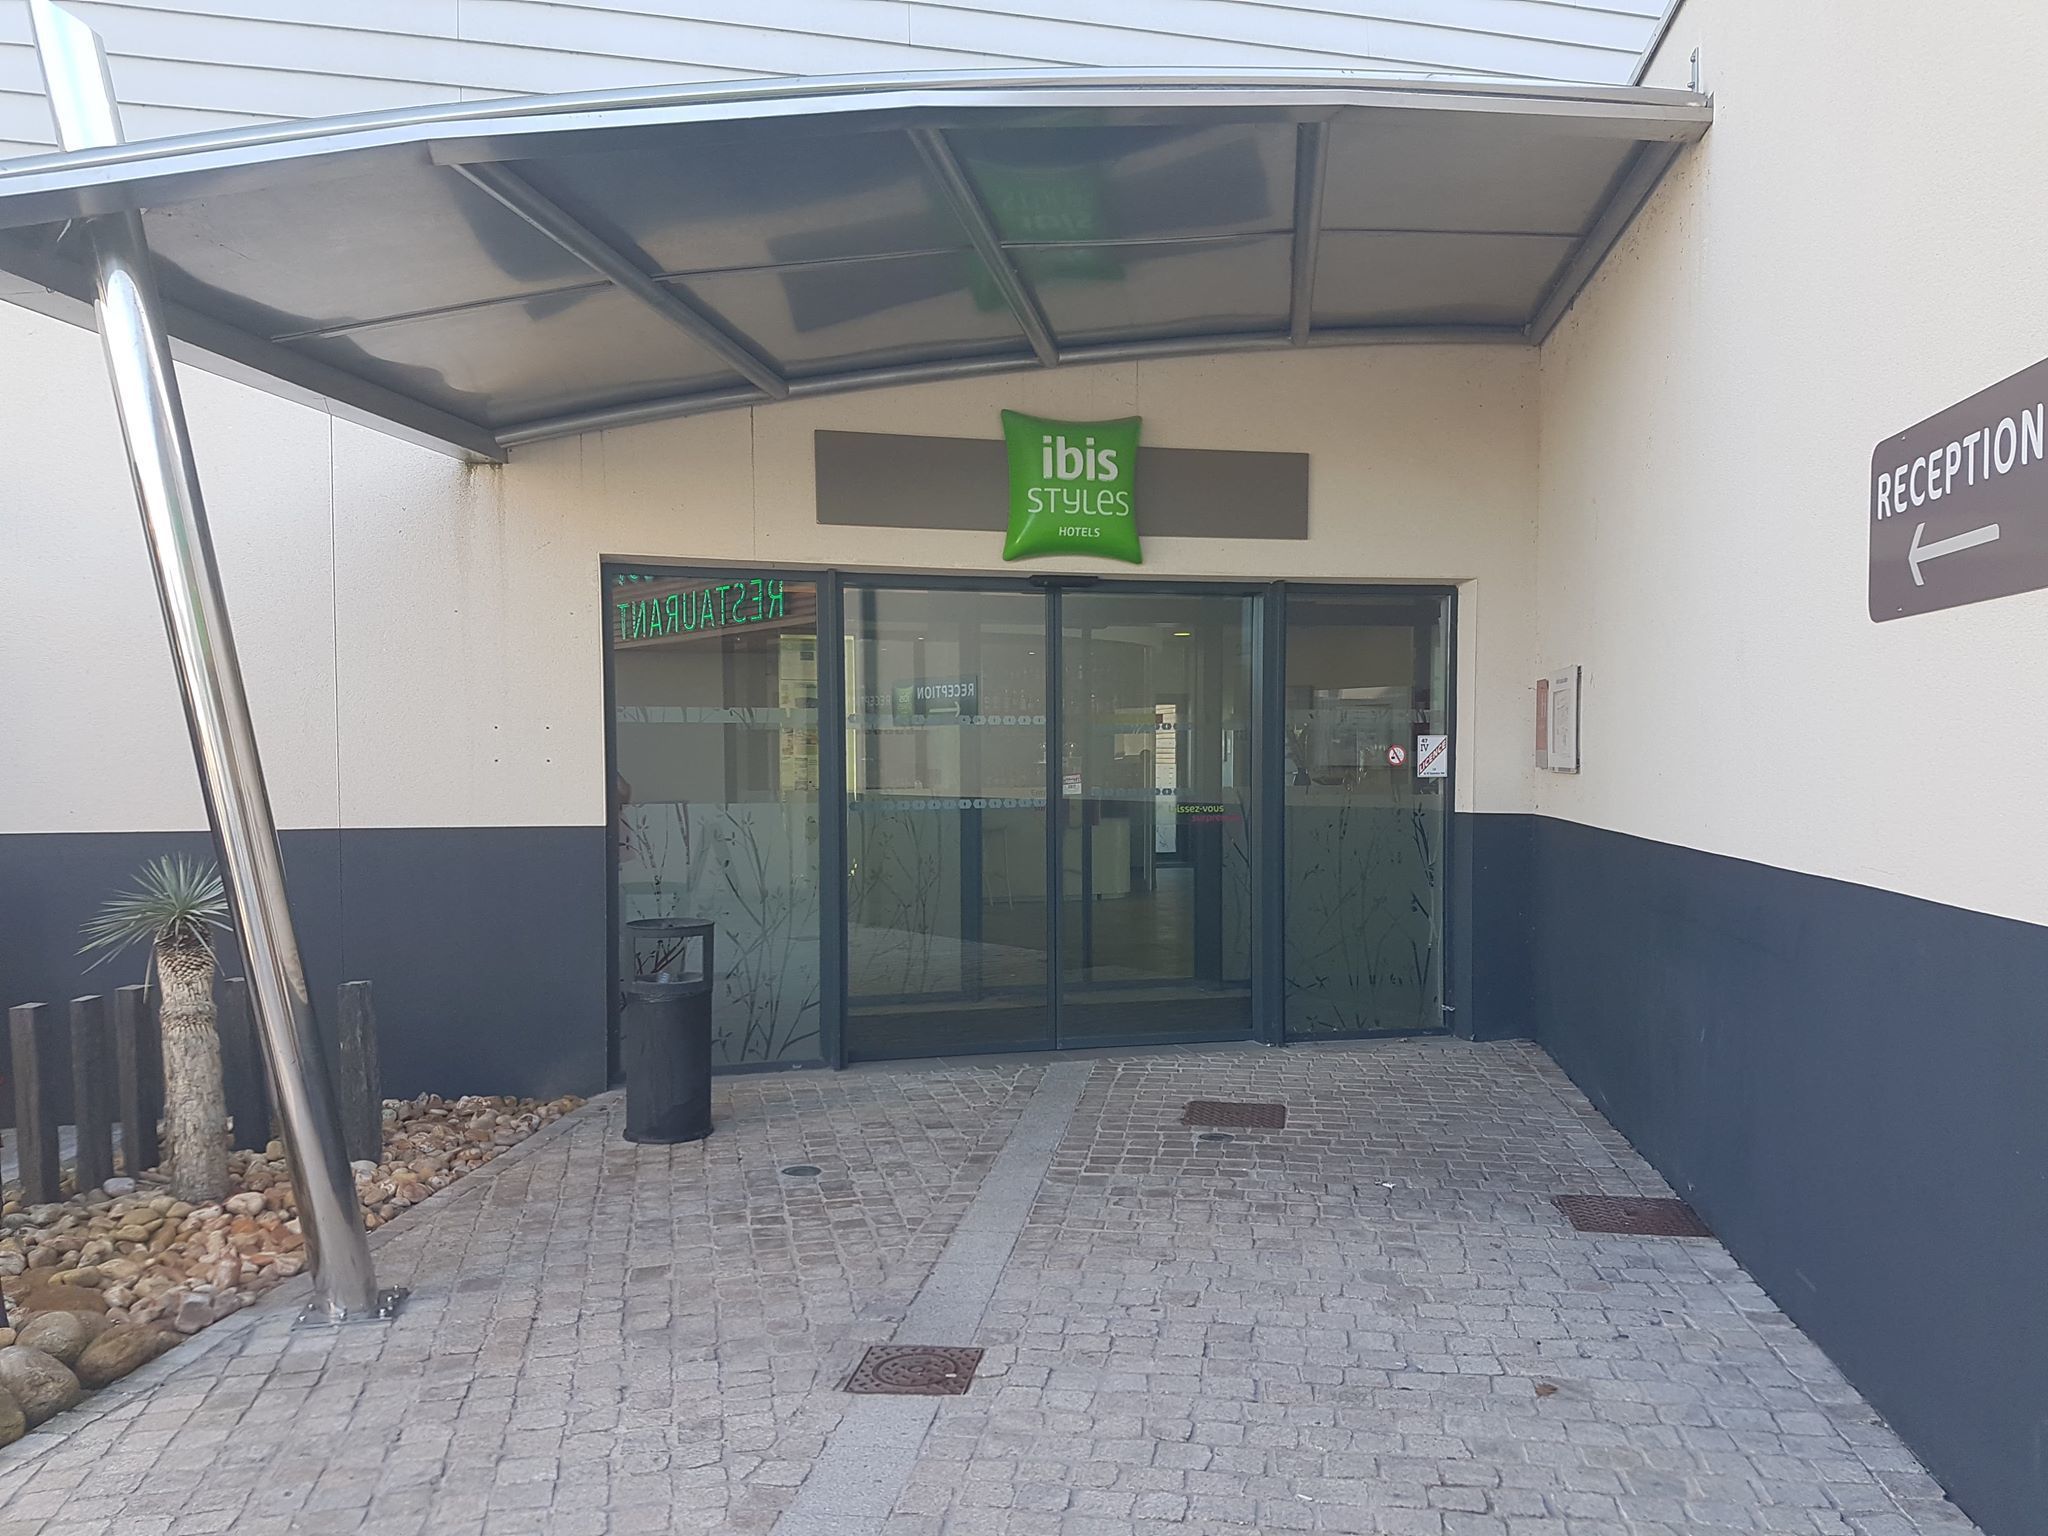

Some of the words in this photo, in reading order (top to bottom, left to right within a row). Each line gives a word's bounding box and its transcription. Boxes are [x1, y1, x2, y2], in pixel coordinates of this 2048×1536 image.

[1042, 435, 1118, 481] ibis
[1877, 402, 2044, 520] RECEPTION
[1058, 526, 1101, 538] HOTELS
[1419, 740, 1446, 772] LICENCE
[1420, 744, 1429, 752] IV
